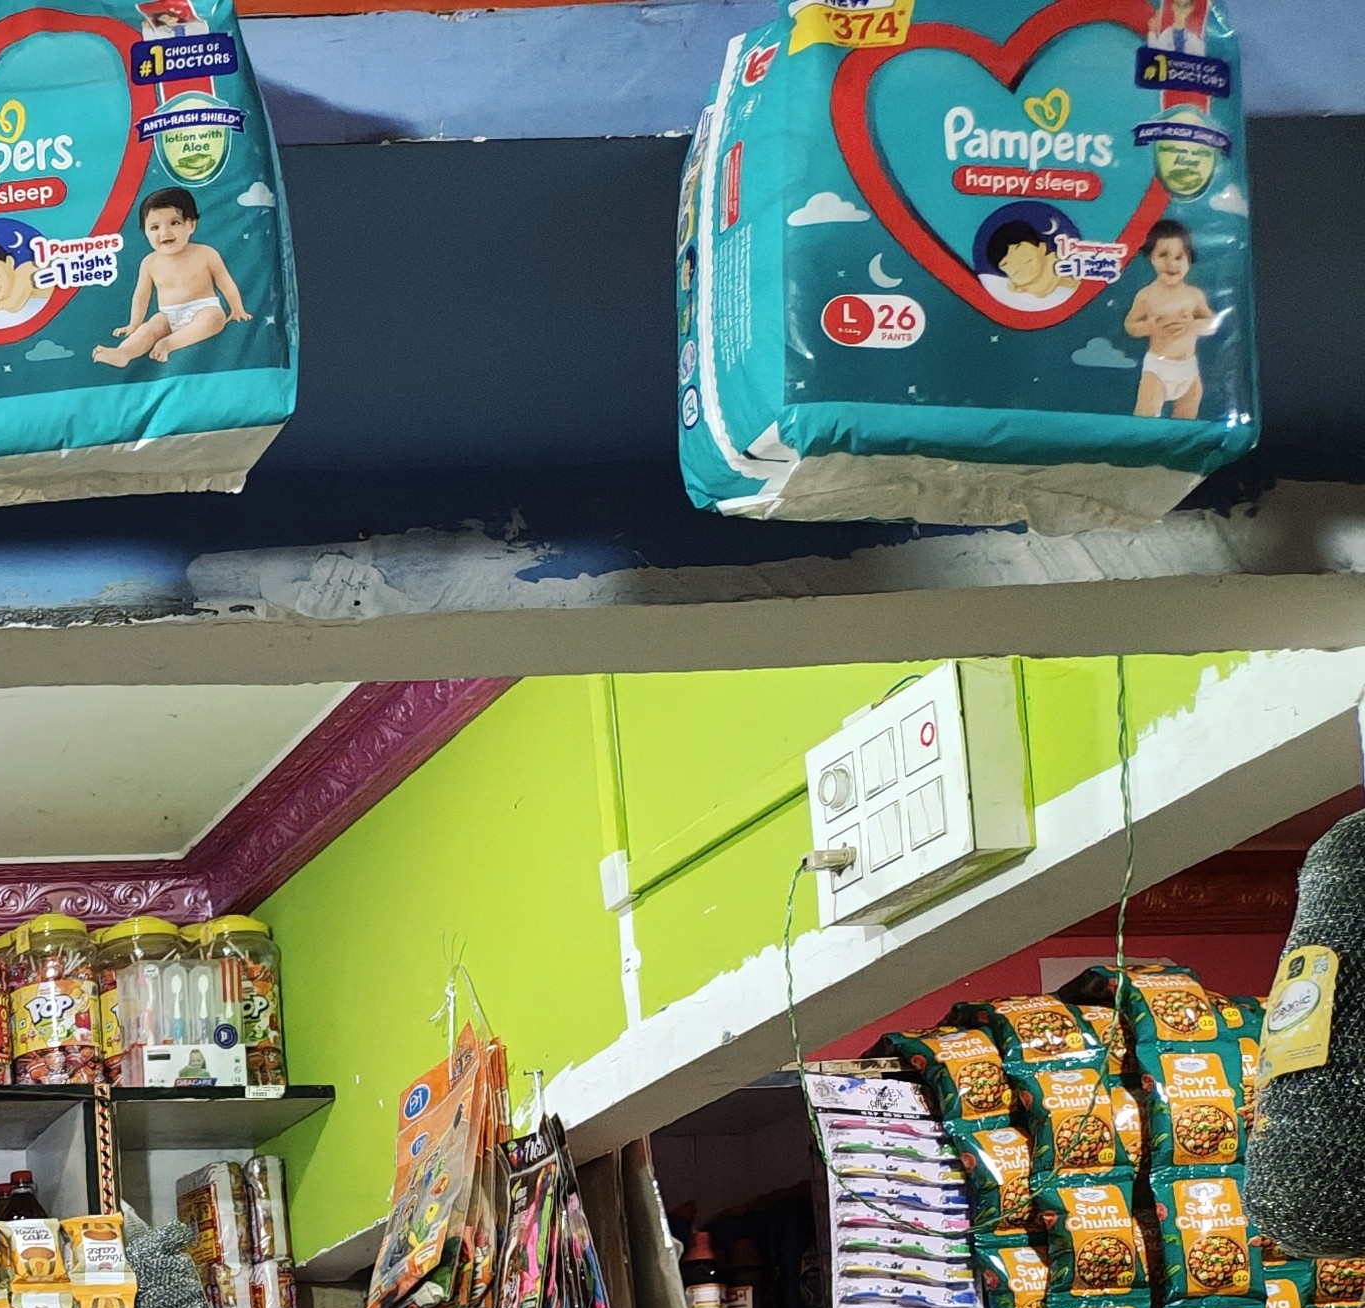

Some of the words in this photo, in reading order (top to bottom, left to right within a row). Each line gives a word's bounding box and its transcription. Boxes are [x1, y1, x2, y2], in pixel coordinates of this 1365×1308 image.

[165, 45, 204, 57] CHOICE
[206, 43, 220, 51] OF
[166, 53, 230, 70] DOCTORS
[143, 113, 199, 133] ANTI-RASH
[165, 133, 196, 144] lotion
[199, 130, 223, 140] with
[943, 106, 1113, 170] Pampers
[183, 143, 211, 153] Aloe
[965, 169, 1031, 195] happy
[1034, 172, 1089, 197] sleep
[50, 236, 119, 256] Pampers
[71, 254, 112, 272] night
[72, 267, 113, 283] sleep
[843, 303, 857, 323] L
[878, 305, 916, 330] 26
[26, 995, 73, 1021] POP
[1172, 1074, 1217, 1087] Soya
[1166, 1086, 1231, 1098] Chunks
[1075, 1204, 1119, 1217] Soya
[1068, 1216, 1131, 1230] Chunks
